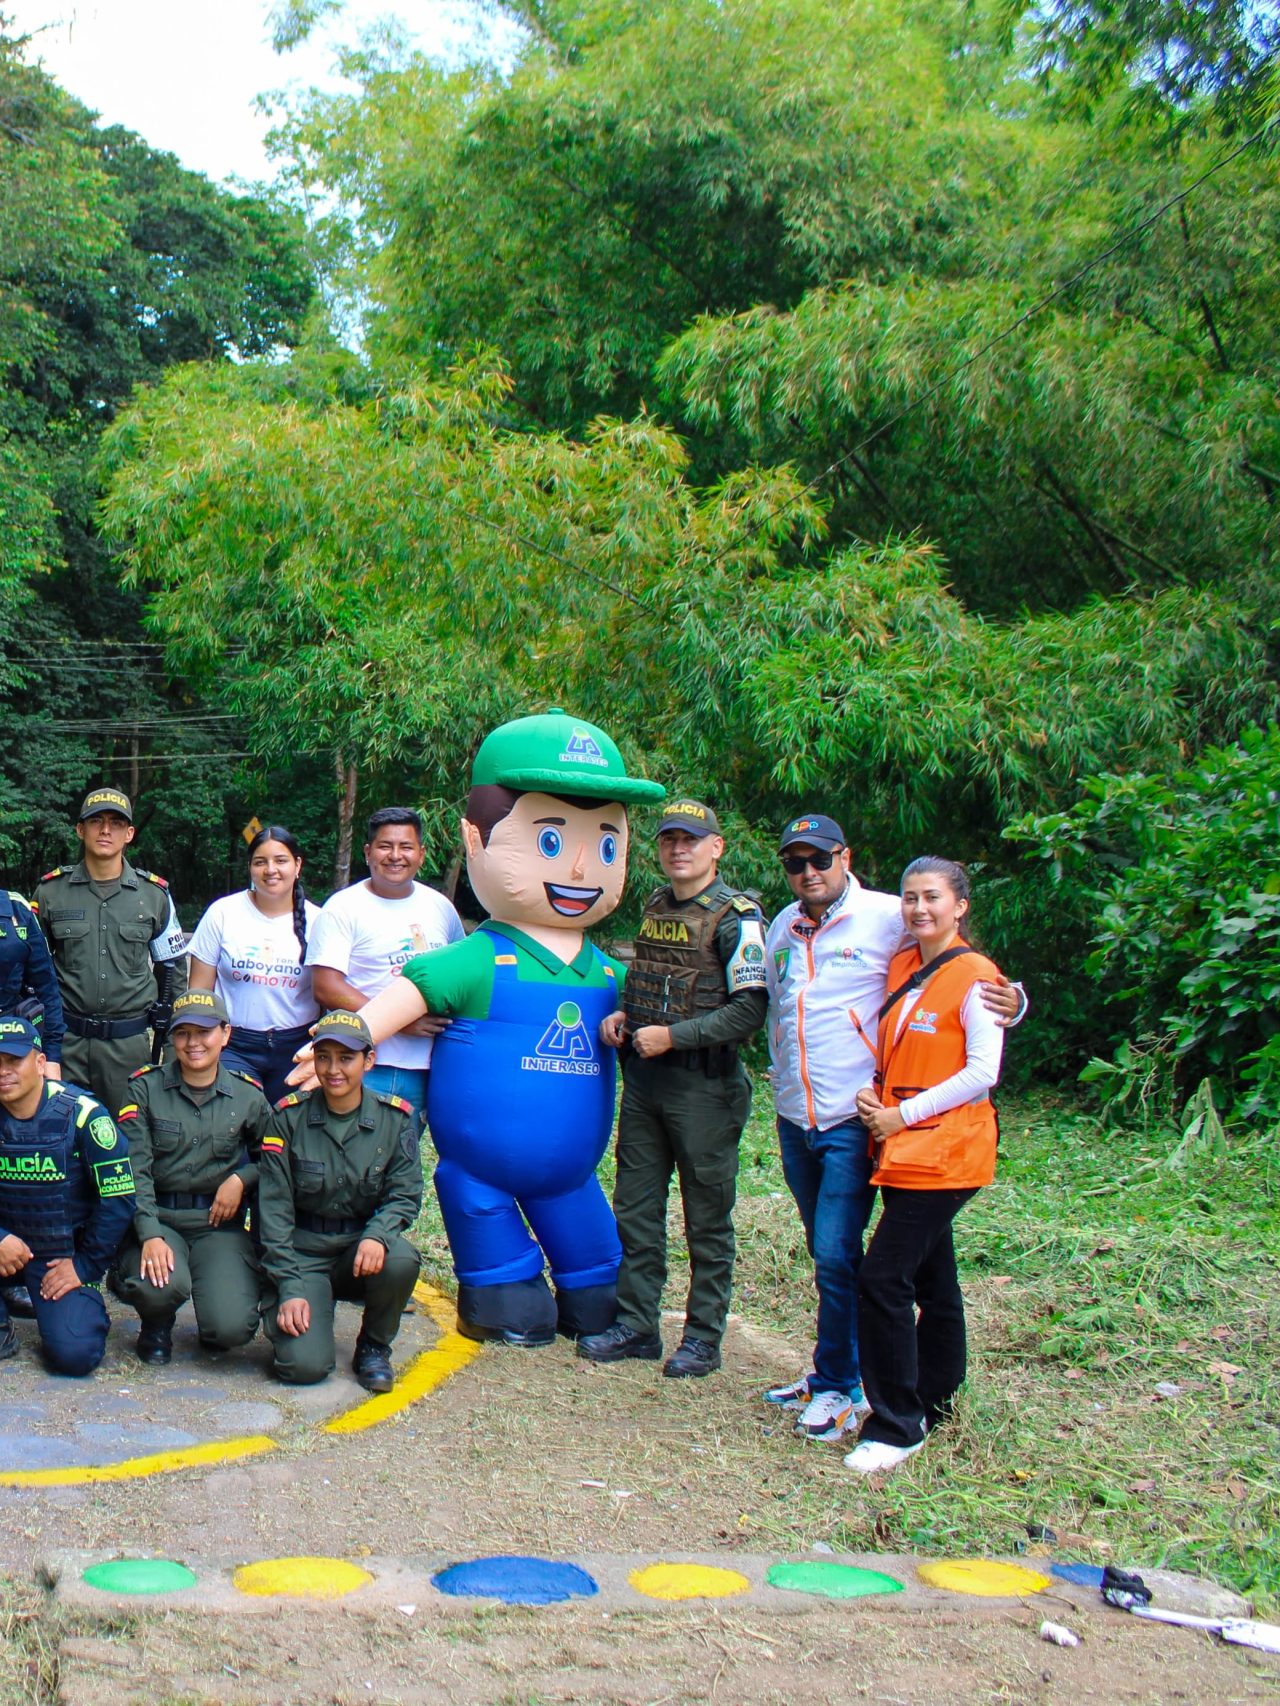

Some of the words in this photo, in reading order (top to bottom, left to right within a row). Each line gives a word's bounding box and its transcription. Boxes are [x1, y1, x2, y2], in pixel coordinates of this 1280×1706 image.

[559, 753, 609, 768] INTERASEO
[88, 793, 127, 809] POLICIA
[640, 918, 689, 943] POLICIA
[231, 957, 302, 976] Laboyano
[173, 994, 214, 1011] POLICIA
[521, 1056, 600, 1076] INTERASEO
